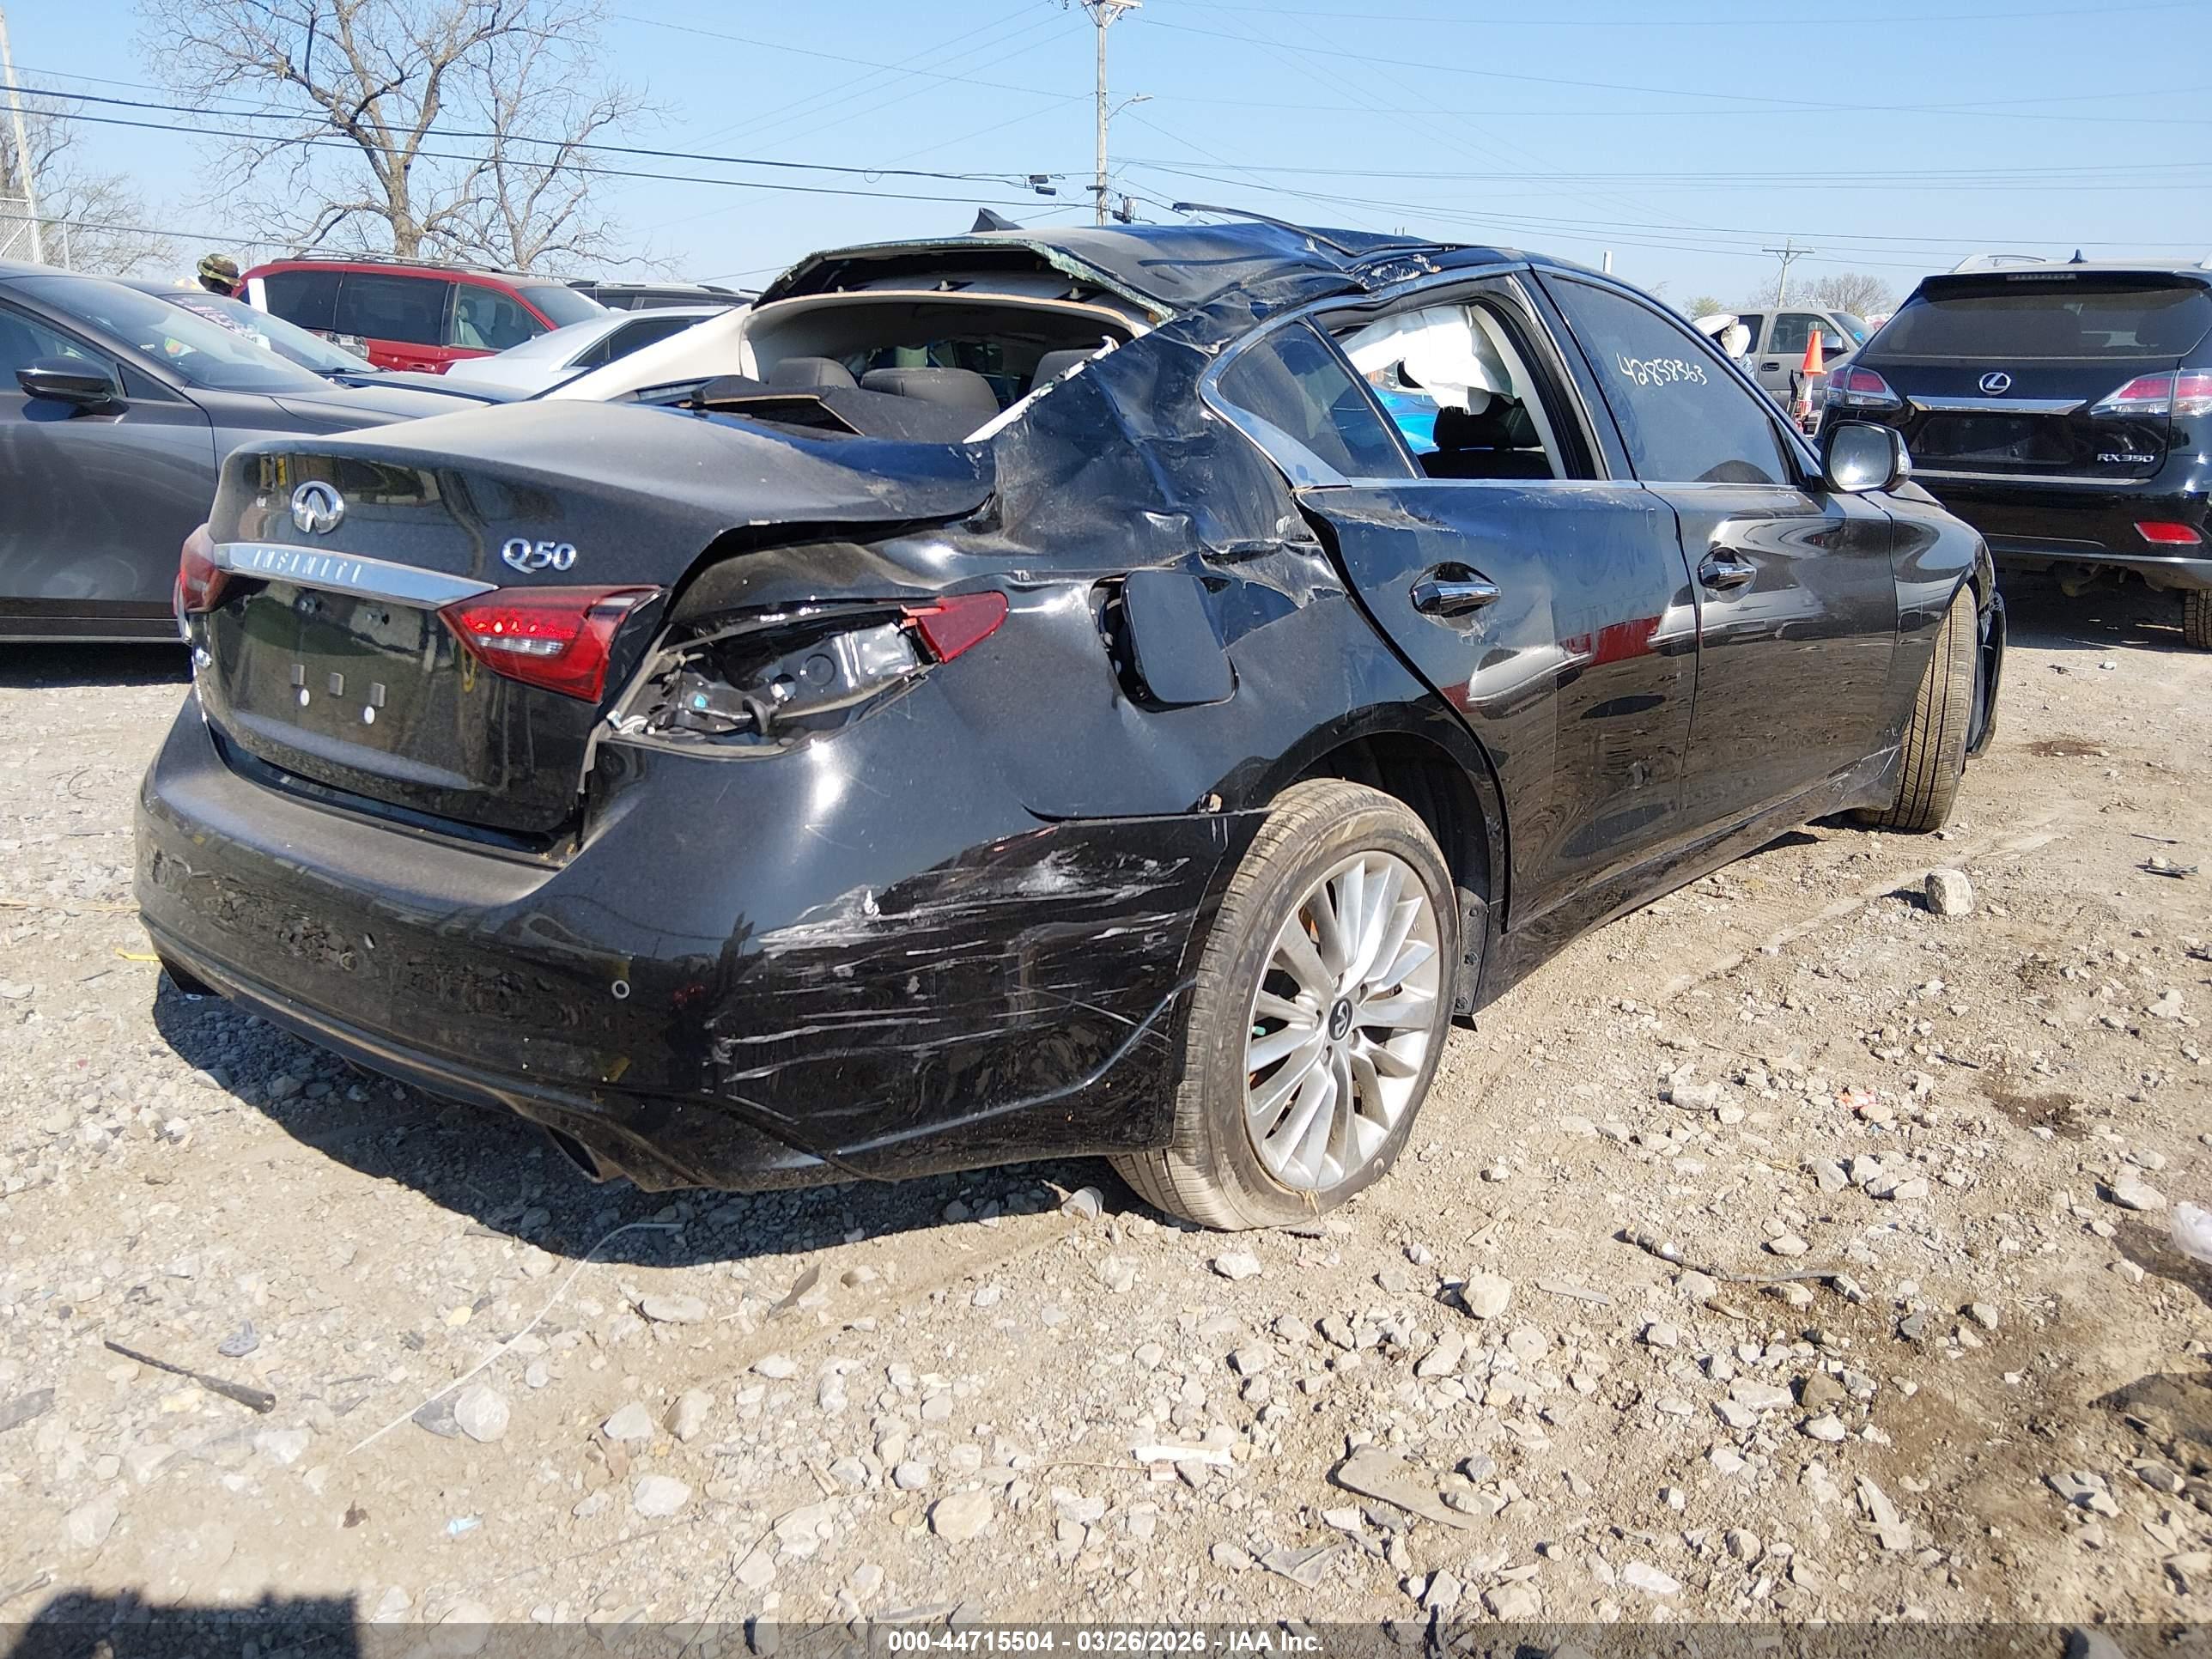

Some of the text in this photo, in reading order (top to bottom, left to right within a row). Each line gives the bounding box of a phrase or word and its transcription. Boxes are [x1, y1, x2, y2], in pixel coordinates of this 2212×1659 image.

[1615, 352, 1708, 386] 42858363
[253, 549, 362, 584] INFINITI
[501, 538, 576, 574] Q50
